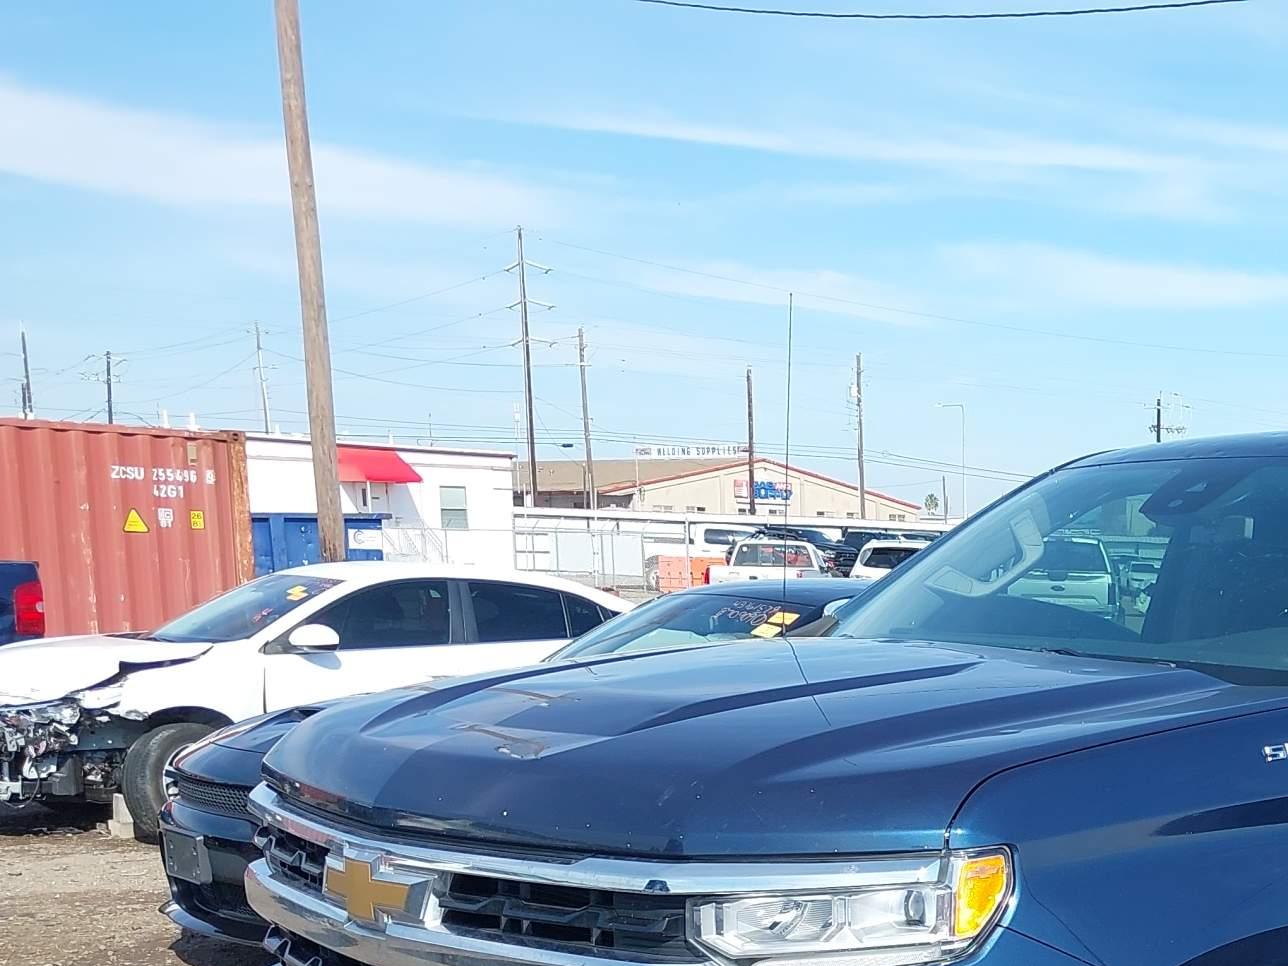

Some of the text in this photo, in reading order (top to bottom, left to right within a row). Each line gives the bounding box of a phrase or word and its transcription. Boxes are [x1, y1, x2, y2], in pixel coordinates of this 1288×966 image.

[656, 447, 691, 456] WELDING
[696, 446, 737, 456] SUPPLIES
[111, 465, 145, 480] ZCSU
[153, 485, 184, 499] 42G1
